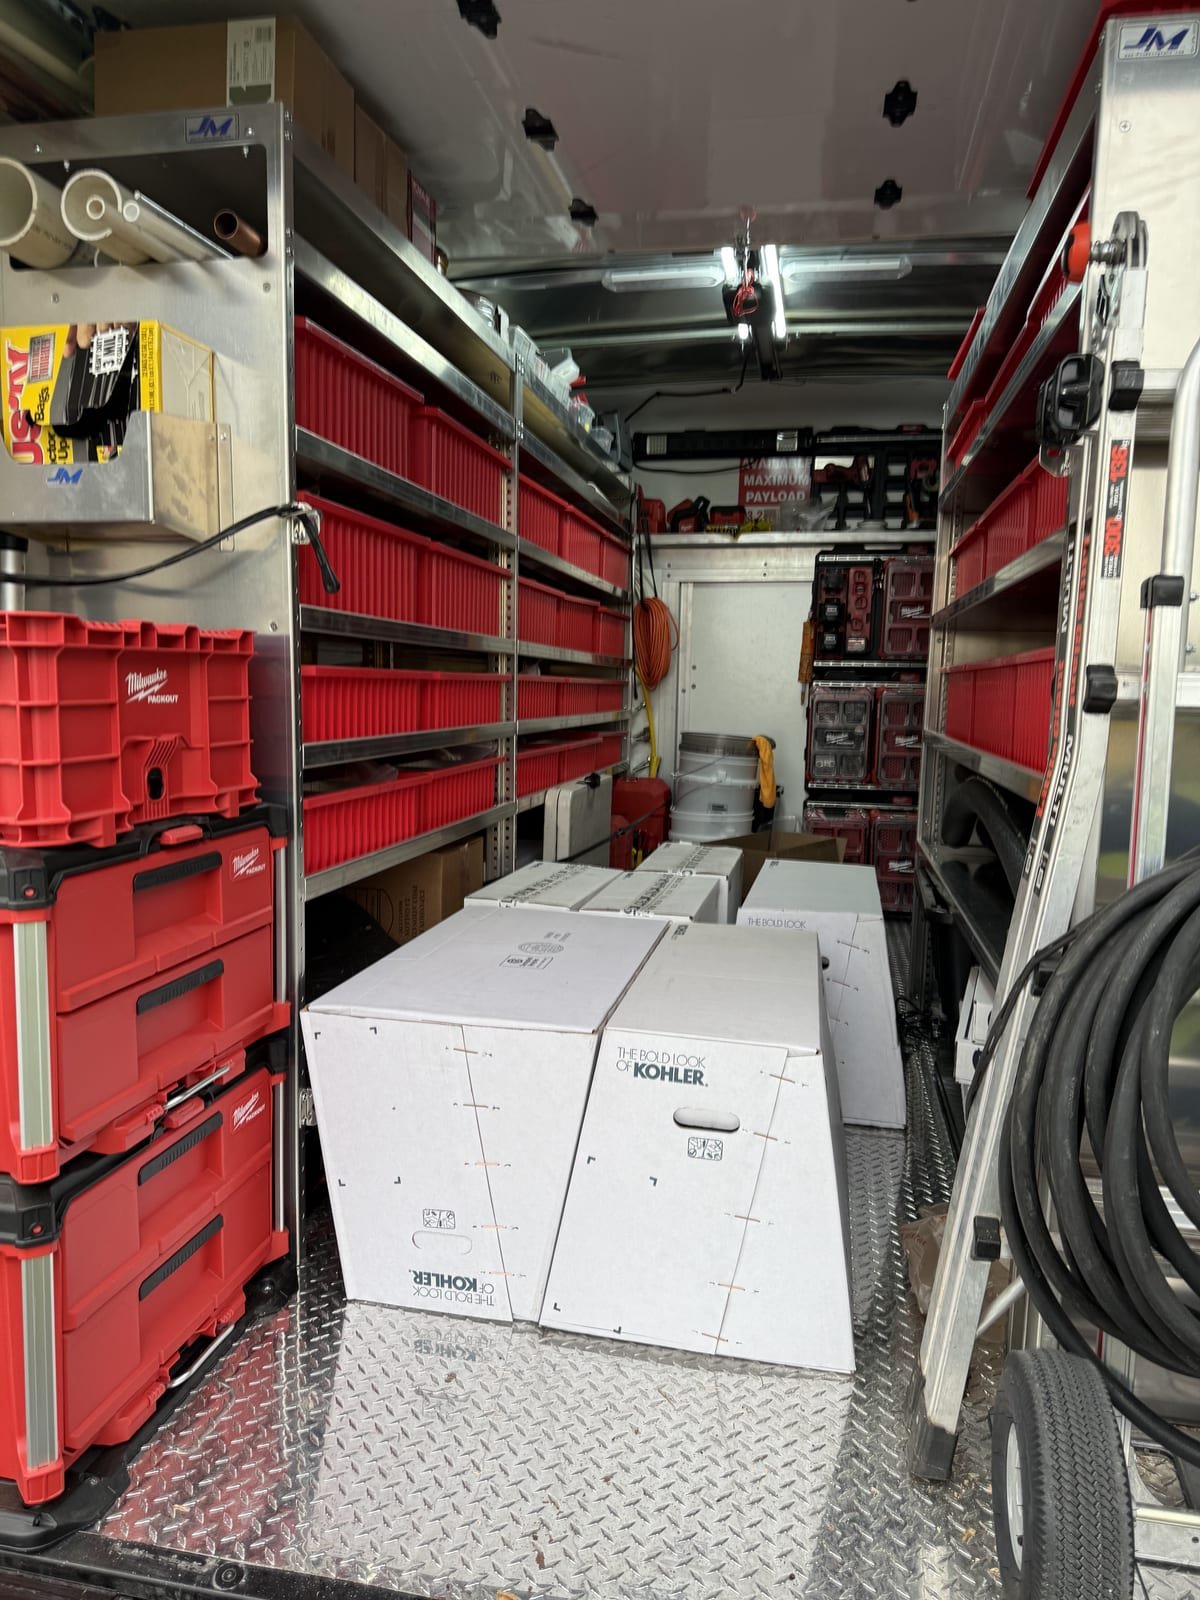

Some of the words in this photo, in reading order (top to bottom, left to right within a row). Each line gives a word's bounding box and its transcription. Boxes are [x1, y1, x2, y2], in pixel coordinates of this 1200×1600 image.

[1123, 25, 1191, 52] JM
[189, 115, 235, 137] JM
[103, 335, 117, 356] MIL
[102, 359, 116, 368] 3
[34, 386, 50, 422] Bags
[1109, 445, 1129, 483] 136
[47, 467, 83, 485] JM
[744, 473, 809, 487] MAXIMUM
[745, 491, 806, 504] PAYLOAD
[1103, 517, 1123, 557] 300
[1061, 541, 1075, 633] MULTI
[125, 667, 168, 697] Milwaukee
[147, 694, 179, 705] PACKOUT
[1050, 734, 1074, 826] MULTI
[747, 917, 761, 927] THE
[762, 918, 783, 928] BOLD
[784, 918, 806, 929] LOOK
[616, 1059, 632, 1072] OF
[617, 1046, 638, 1060] THE
[640, 1049, 671, 1064] BOLD
[673, 1053, 706, 1069] LOOK
[412, 1286, 442, 1299] LOOK
[444, 1290, 473, 1304] BOLD
[480, 1283, 495, 1294] OF
[475, 1295, 495, 1306] THE
